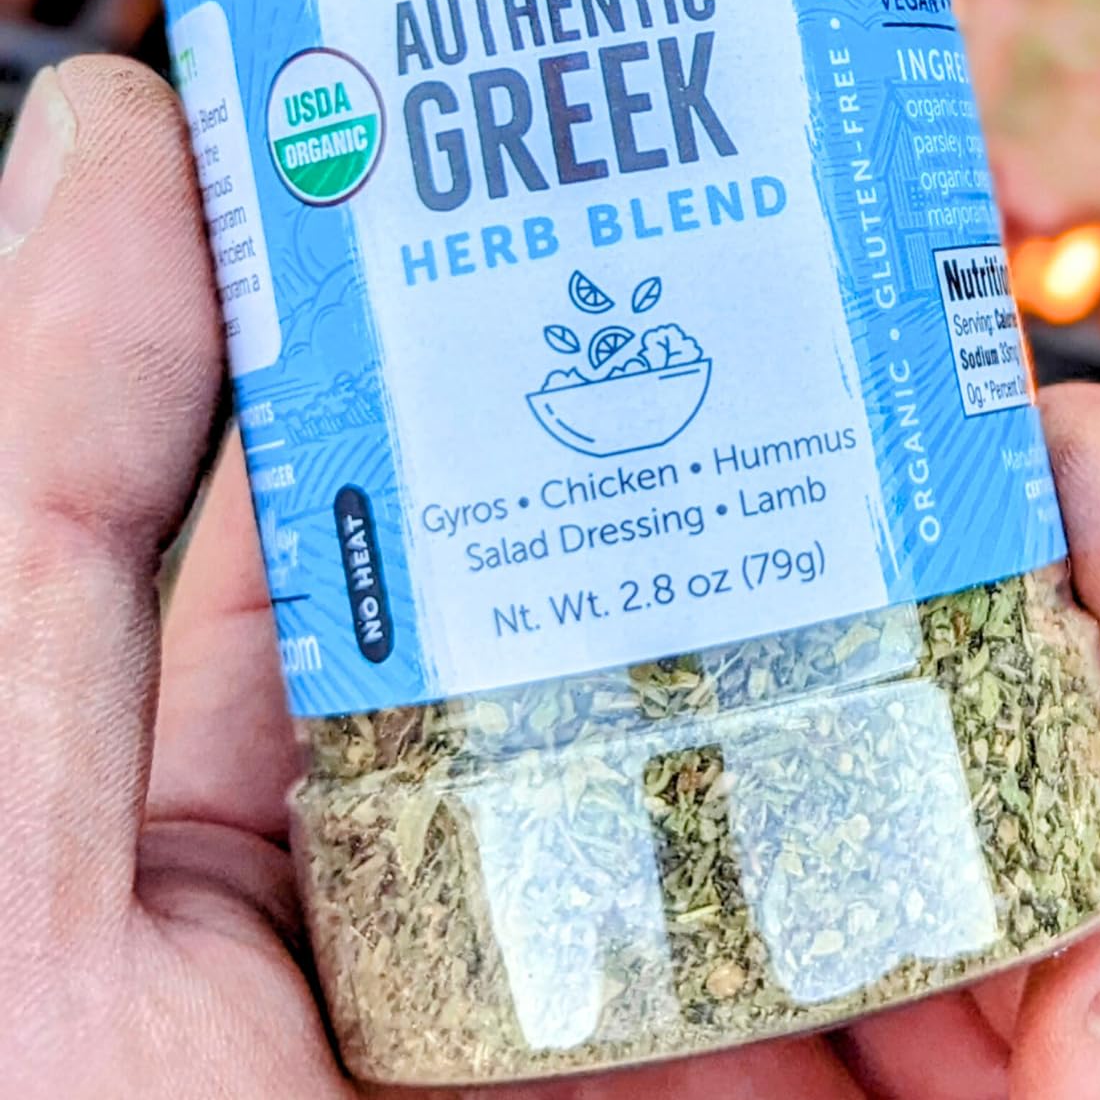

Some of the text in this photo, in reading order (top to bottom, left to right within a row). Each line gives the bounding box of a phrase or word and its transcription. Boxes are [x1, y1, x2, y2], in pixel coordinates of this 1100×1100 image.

[284, 81, 353, 127] USDA
[896, 48, 969, 84] INGRE
[906, 95, 959, 123] organic
[285, 124, 369, 169] ORGANIC
[402, 30, 739, 212] GREEK
[828, 47, 897, 309] GLUTEN-FREE
[920, 164, 975, 194] organic
[400, 175, 788, 286] HERB BLEND
[960, 345, 999, 371] Sodium
[422, 427, 857, 538] Gyros Chicken Hummus
[890, 358, 940, 543] ORGANIC
[465, 476, 827, 573] Salad Dressing Lamb
[344, 514, 383, 645] NO HEAT
[493, 540, 826, 638] Nt. Wt. 2.8 oz (79g)
